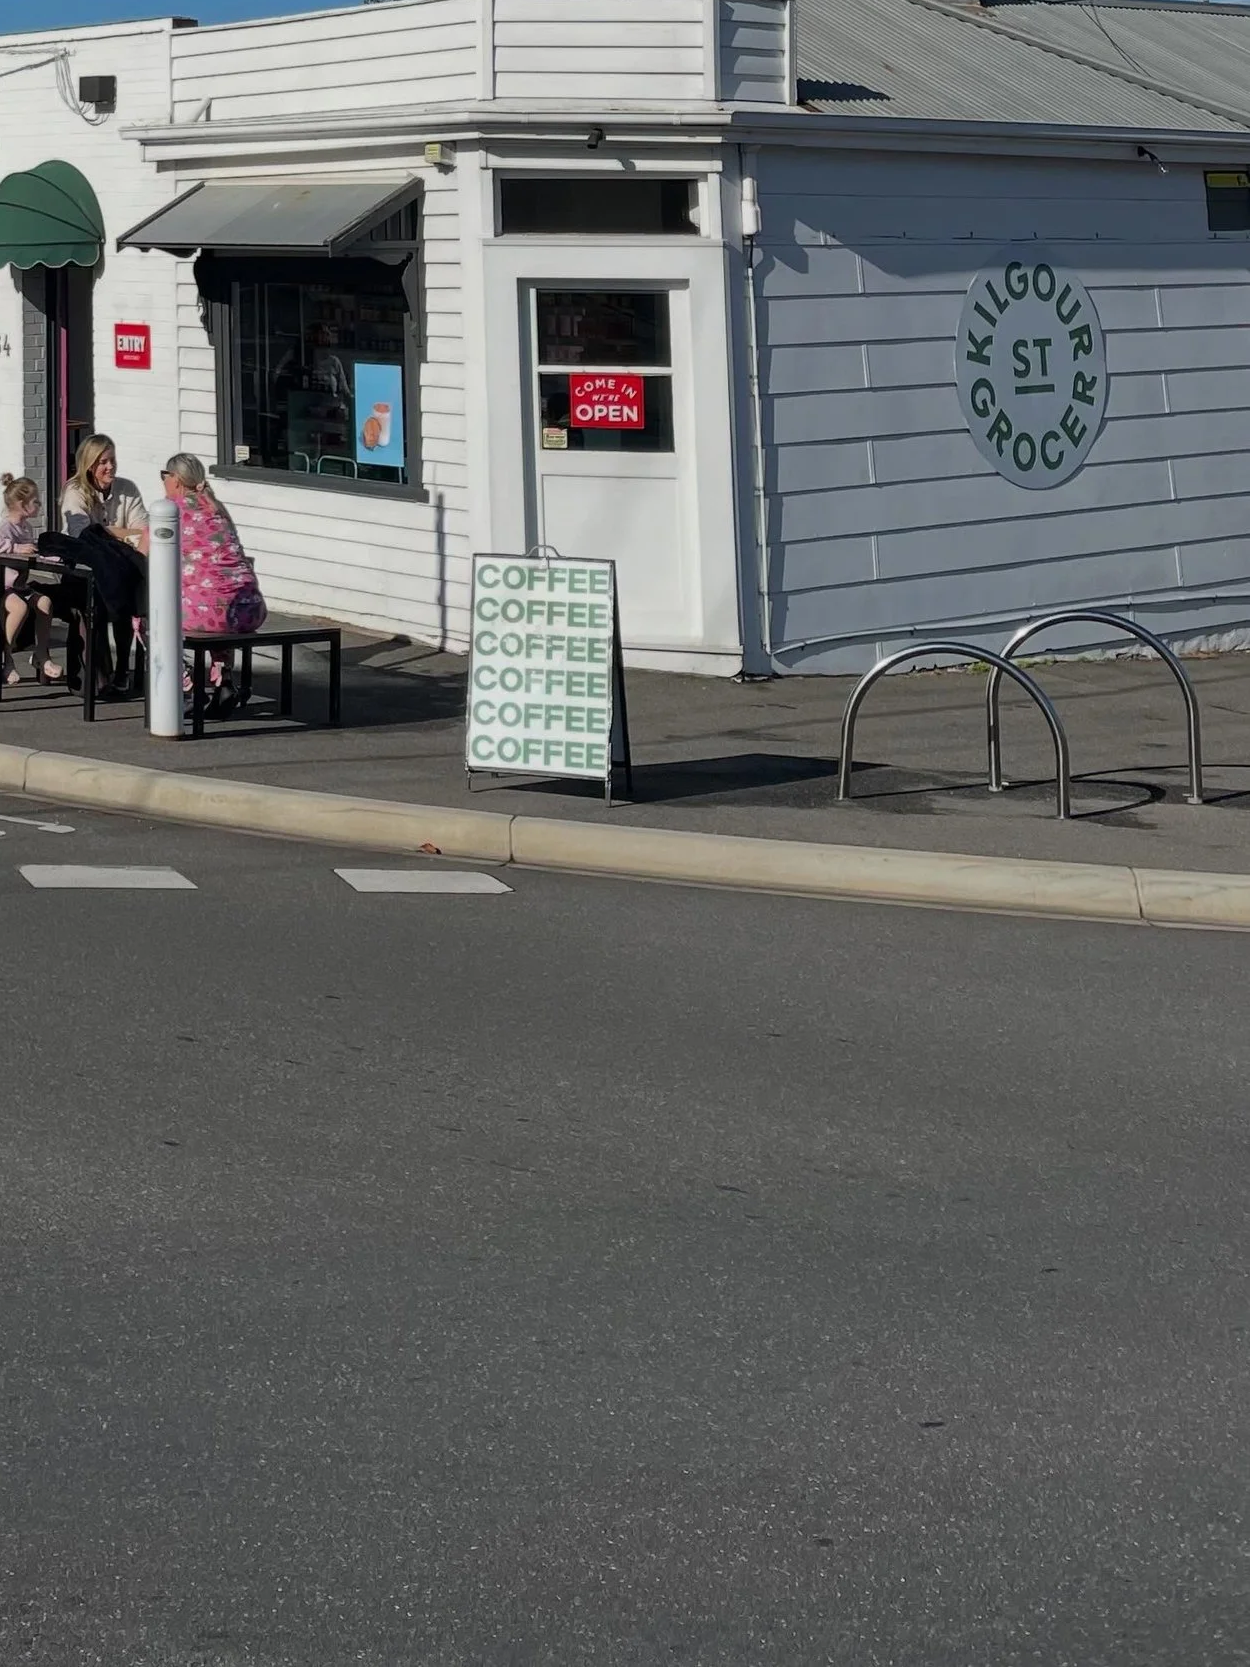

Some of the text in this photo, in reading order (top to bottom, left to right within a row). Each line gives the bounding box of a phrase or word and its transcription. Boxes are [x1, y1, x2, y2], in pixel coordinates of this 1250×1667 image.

[966, 261, 1093, 366] KILGOUR
[116, 335, 146, 353] ENTRY
[1012, 338, 1052, 379] ST
[575, 378, 638, 399] COME IN
[591, 394, 621, 402] WE'RE
[575, 404, 639, 422] OPEN
[970, 370, 1098, 472] GROCER
[477, 564, 608, 594] COFFEE
[476, 597, 608, 628] COFFEE
[475, 631, 607, 663] COFFEE
[474, 665, 607, 698] COFFEE
[473, 700, 607, 734] COFFEE
[471, 734, 606, 769] COFFEE
